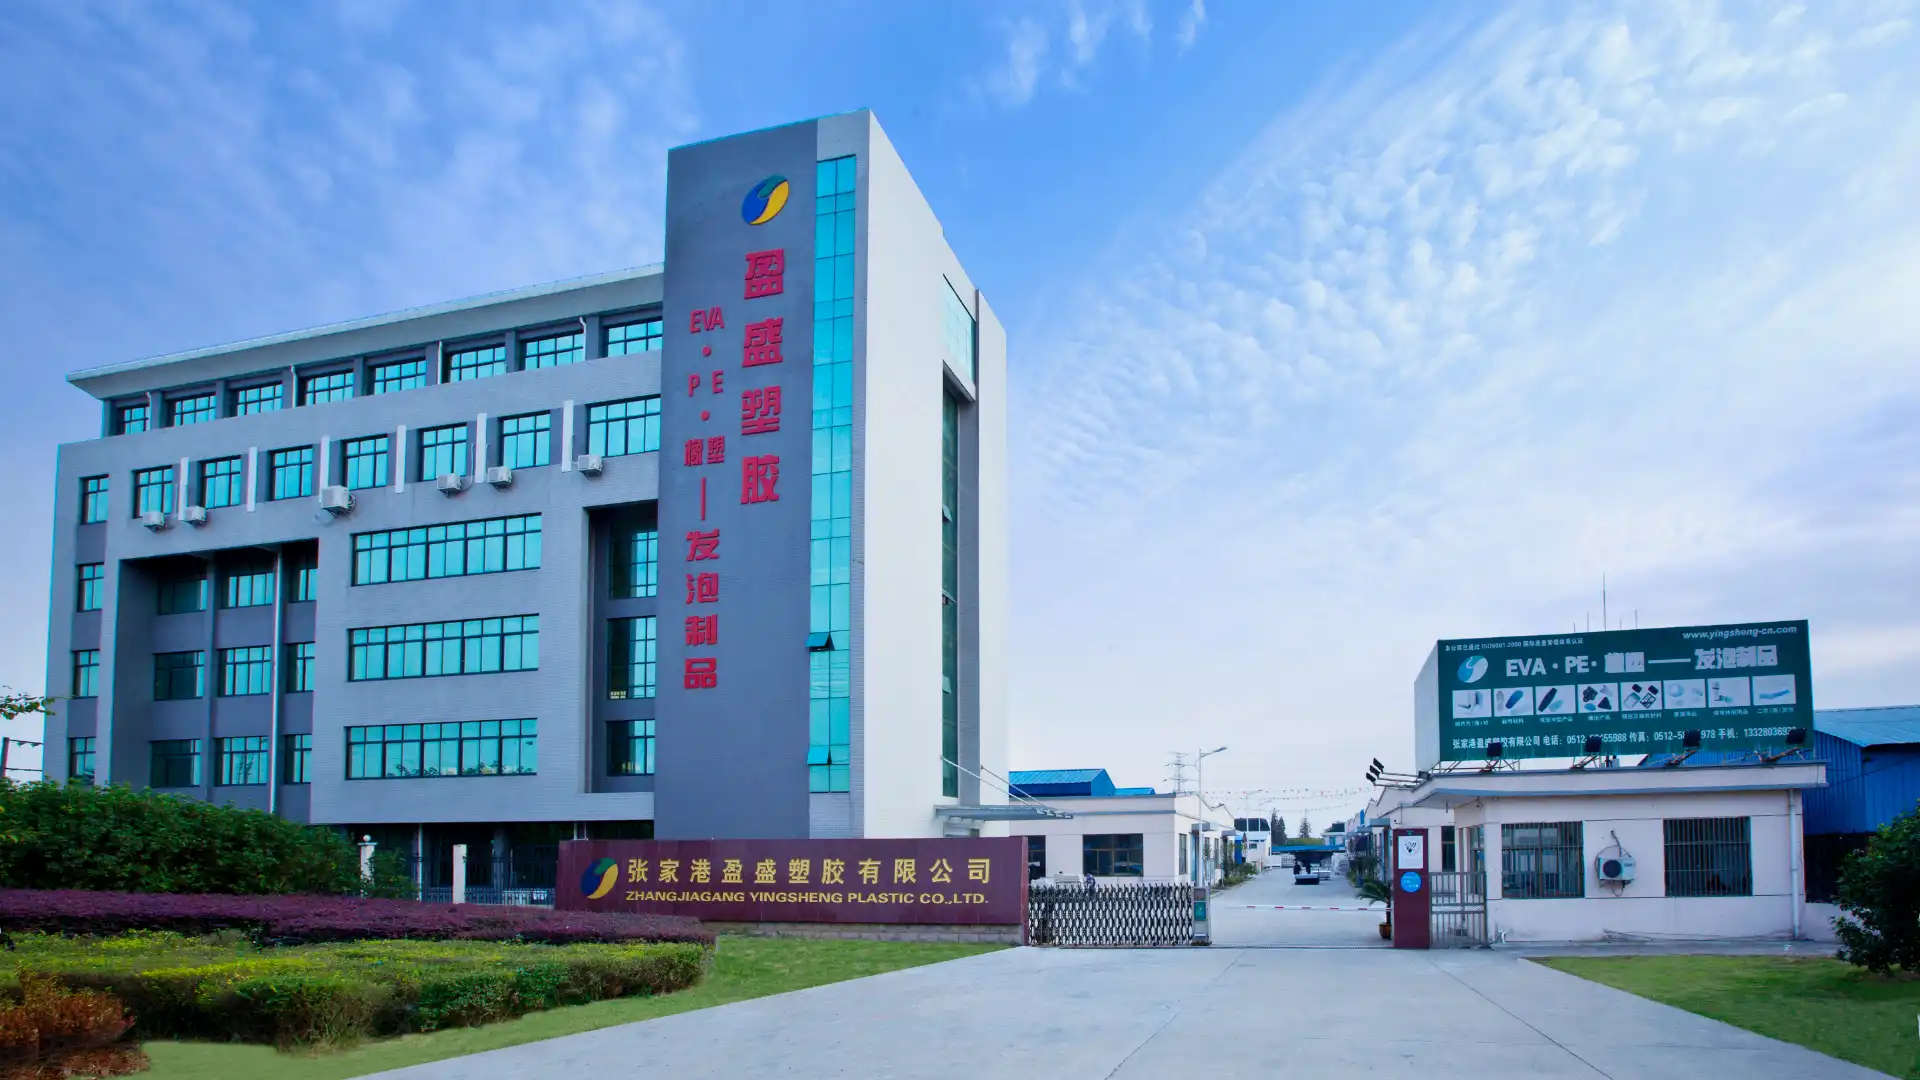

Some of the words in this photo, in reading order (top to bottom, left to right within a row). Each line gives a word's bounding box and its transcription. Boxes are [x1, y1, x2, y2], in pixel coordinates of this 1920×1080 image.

[689, 306, 725, 333] EVA
[740, 248, 784, 504] 盈盛塑胶
[684, 528, 720, 689] 发泡制品
[1682, 626, 1797, 640] www.yingsheng-cn.com
[1505, 657, 1547, 677] EVA
[1566, 732, 1627, 744] 0512-55988
[628, 858, 990, 884] 张家港盈盛塑胶有限公司
[625, 891, 745, 902] ZHANGJIAGANG
[749, 891, 843, 903] YINGSHENG
[847, 892, 914, 904] PLASTIC
[919, 893, 989, 905] CO.,LTD.
